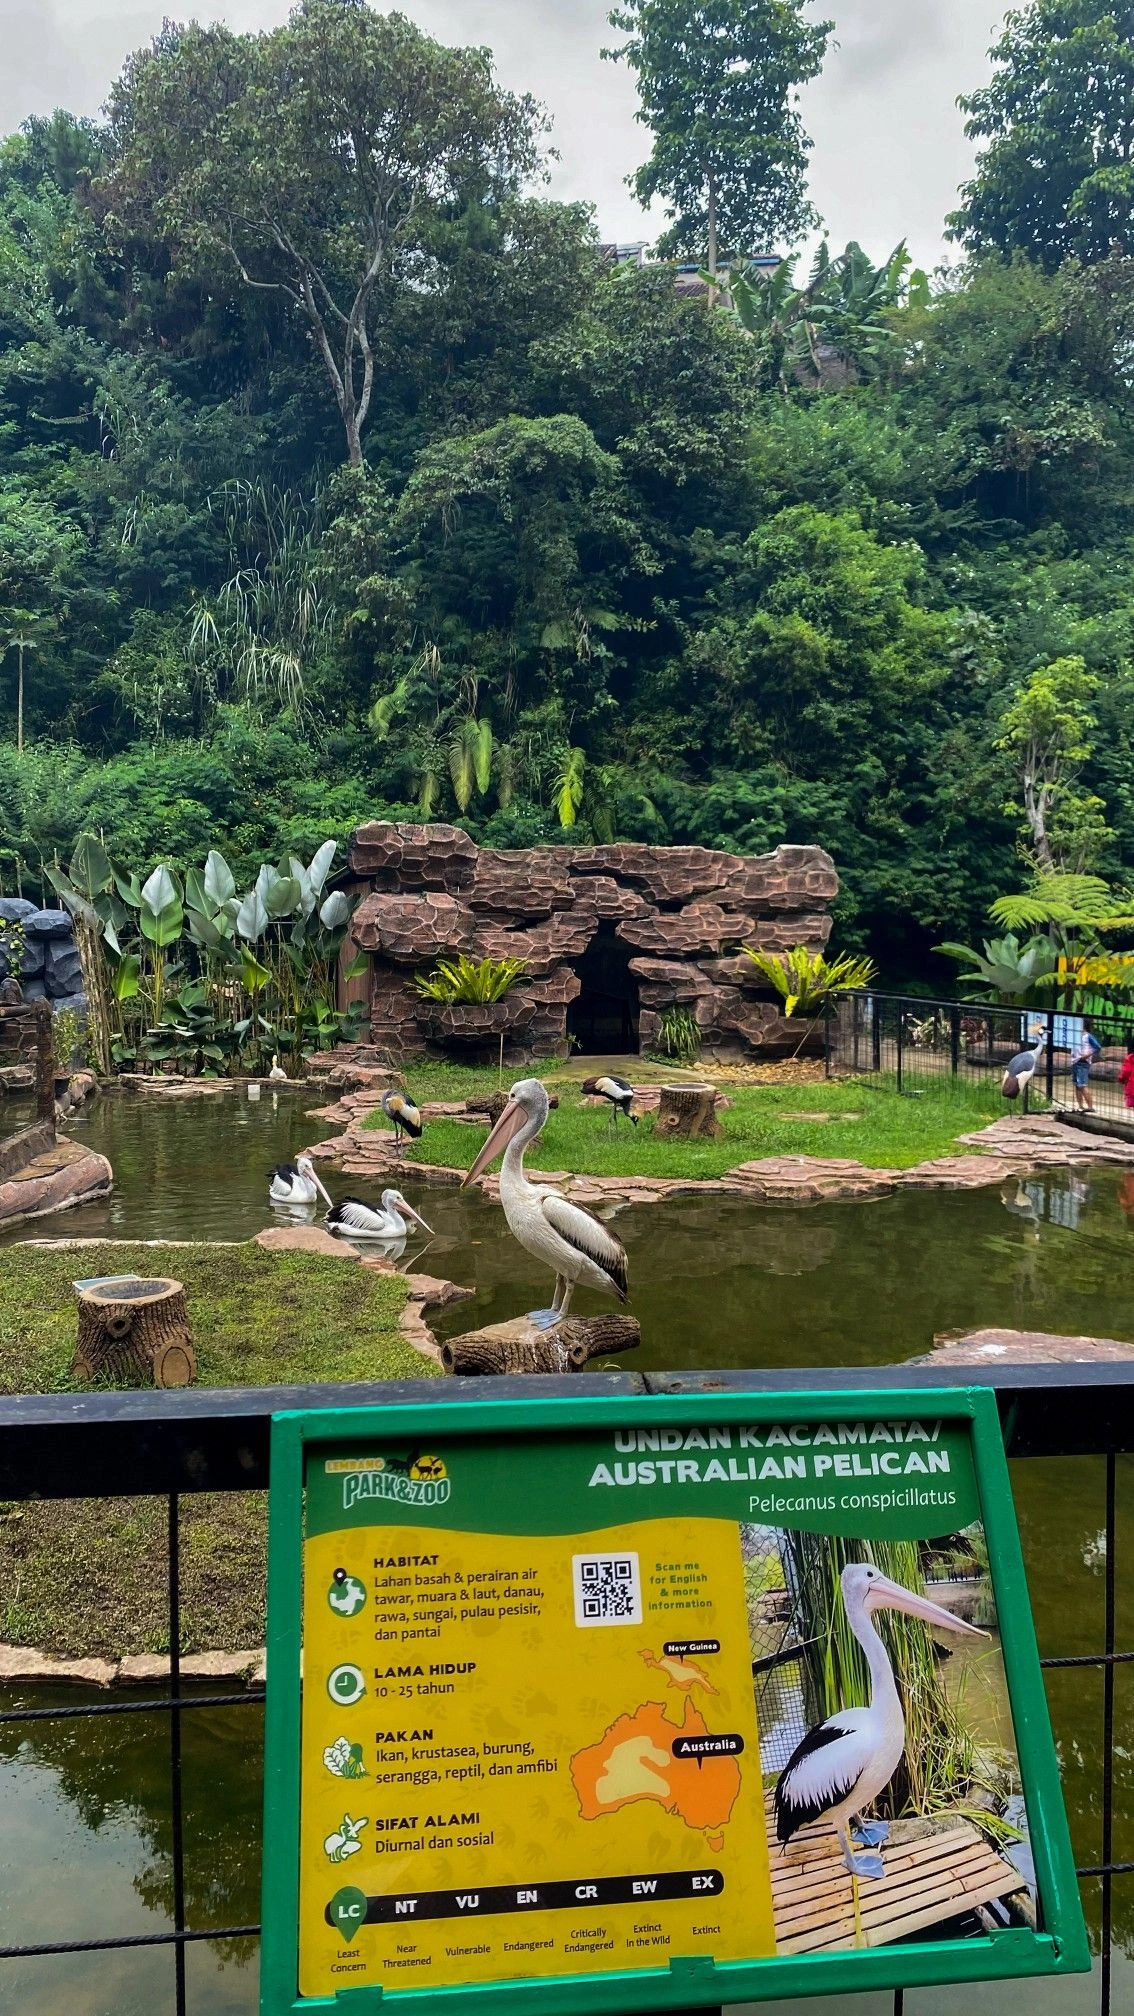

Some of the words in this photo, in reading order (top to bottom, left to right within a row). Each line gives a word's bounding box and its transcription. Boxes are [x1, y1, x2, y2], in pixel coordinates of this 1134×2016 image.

[614, 1425, 732, 1453] UNDAN
[739, 1419, 943, 1448] KACAMATA/
[588, 1455, 808, 1487] AUSTRALIAN
[814, 1450, 951, 1478] PELICAN
[343, 1472, 450, 1509] PARK&ZOO
[748, 1494, 836, 1513] Pelecanus
[840, 1488, 957, 1512] conspicillatus
[373, 1554, 439, 1568] HABITAT
[655, 1562, 680, 1572] Scan
[683, 1562, 701, 1571] me
[374, 1574, 412, 1589] Lahan
[415, 1571, 451, 1586] basah
[454, 1571, 464, 1585] &
[467, 1569, 518, 1585] perairan
[521, 1568, 538, 1581] air
[649, 1575, 667, 1585] for
[669, 1572, 708, 1587] English
[374, 1591, 413, 1607] tawar,
[416, 1590, 456, 1603] muara
[459, 1588, 470, 1601] &
[473, 1586, 501, 1603] laut,
[504, 1584, 544, 1600] danau,
[660, 1588, 669, 1598] &
[672, 1587, 700, 1597] more
[648, 1599, 713, 1611] information
[374, 1610, 409, 1625] rawa,
[412, 1606, 457, 1624] sungai,
[460, 1603, 496, 1622] pulau
[498, 1602, 541, 1620] pesisir,
[374, 1626, 398, 1641] dan
[401, 1624, 441, 1643] pantai
[667, 1642, 687, 1653] New
[689, 1641, 718, 1653] Guinea
[373, 1665, 426, 1680] LAMA
[429, 1662, 476, 1676] HIDUP
[374, 1686, 388, 1697] 10
[398, 1685, 413, 1700] 25
[415, 1680, 455, 1696] tahun
[375, 1729, 435, 1744] PAKAN
[680, 1737, 738, 1753] Australia
[375, 1747, 408, 1765] Ikan,
[411, 1743, 480, 1763] krustasea,
[483, 1741, 535, 1761] burung,
[375, 1768, 441, 1785] serangga,
[444, 1763, 485, 1782] reptil,
[488, 1760, 513, 1776] dan
[516, 1757, 559, 1774] amfibi
[375, 1815, 418, 1832] SIFAT
[423, 1812, 481, 1828] ALAMI
[375, 1834, 425, 1854] Diurnal
[428, 1834, 453, 1850] dan
[456, 1830, 495, 1848] sosial
[338, 1903, 360, 1920] LC
[394, 1899, 418, 1915] NT
[455, 1894, 480, 1910] VU
[516, 1889, 538, 1904] EN
[574, 1884, 598, 1899] CR
[631, 1879, 658, 1894] EW
[691, 1875, 715, 1890] EX
[570, 1926, 607, 1941] Critically
[633, 1922, 662, 1934] Extinct
[692, 1923, 722, 1936] Extinct
[503, 1937, 554, 1953] Endangered
[564, 1939, 614, 1954] Endangered
[626, 1936, 635, 1947] in
[637, 1936, 652, 1947] the
[653, 1933, 671, 1947] Wild
[336, 1947, 360, 1959] Least
[396, 1942, 418, 1954] Near
[445, 1943, 492, 1957] Vulnerable
[330, 1960, 367, 1974] Concern
[382, 1954, 432, 1969] Threatened
